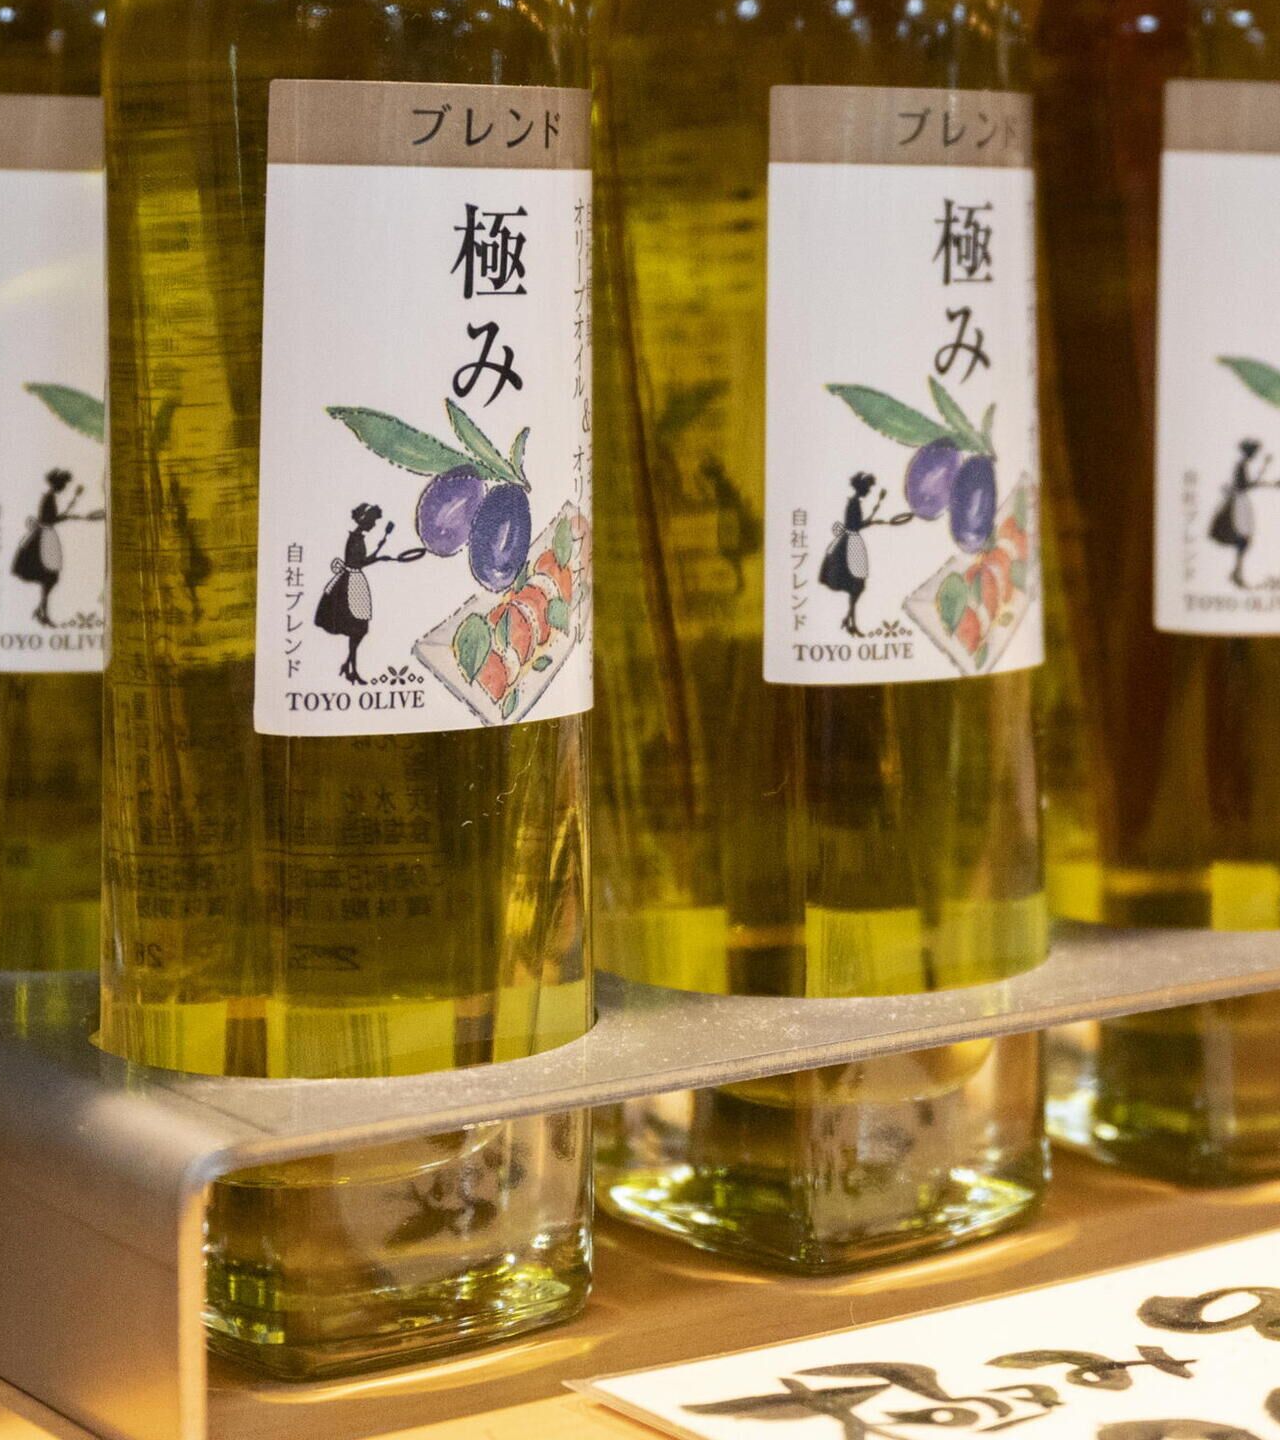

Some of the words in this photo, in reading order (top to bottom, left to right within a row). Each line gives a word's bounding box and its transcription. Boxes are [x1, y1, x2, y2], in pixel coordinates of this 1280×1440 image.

[411, 105, 561, 149] ブレンド
[450, 203, 529, 408] 極み
[931, 197, 994, 385] 極み
[284, 542, 304, 678] 自社ブレンド
[791, 508, 808, 631] 自社ブレンド
[285, 692, 352, 712] TOYO
[358, 690, 425, 710] OLIVE
[792, 644, 852, 662] TOYO
[858, 643, 915, 661] OLIVE
